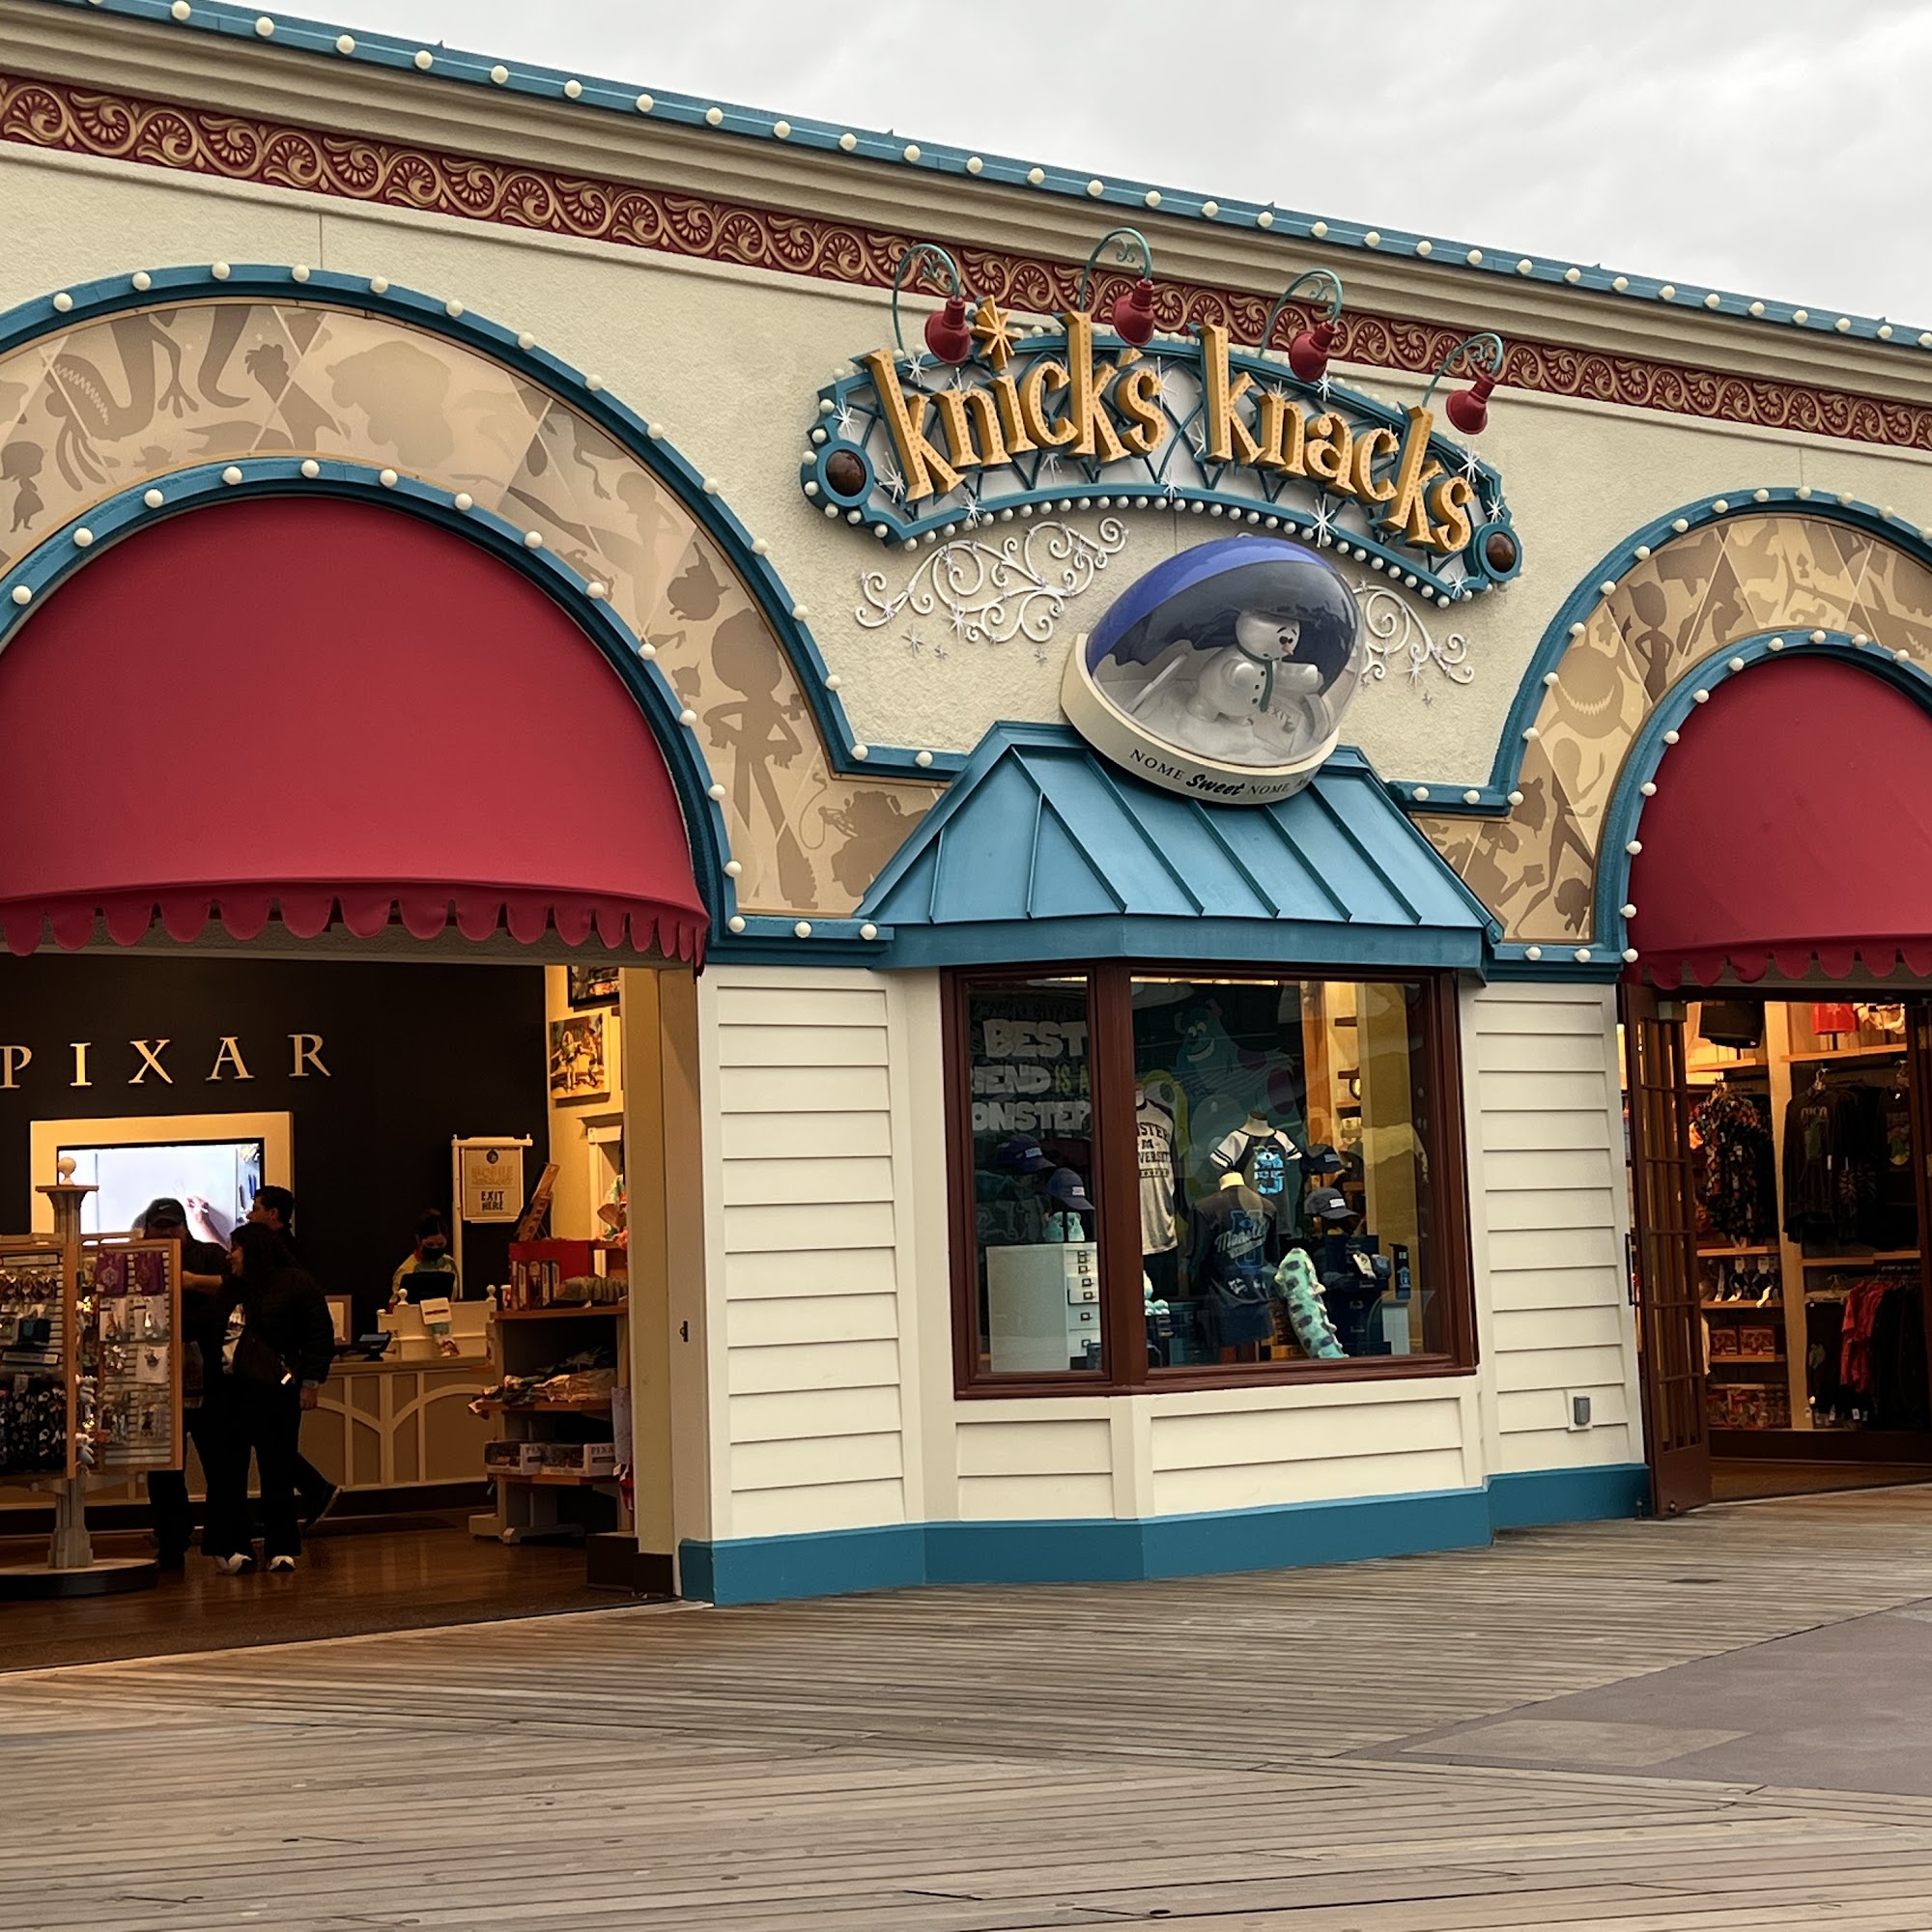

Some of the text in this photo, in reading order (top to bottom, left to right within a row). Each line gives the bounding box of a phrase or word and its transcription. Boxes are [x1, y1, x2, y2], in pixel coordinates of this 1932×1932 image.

[863, 296, 1476, 554] knick's knacks
[1129, 748, 1291, 797] NOME Sweet NOME
[982, 1018, 1089, 1059] BEST
[0, 1034, 331, 1090] PIXAR
[970, 1064, 1052, 1095] IEND
[481, 1190, 505, 1202] EXIT
